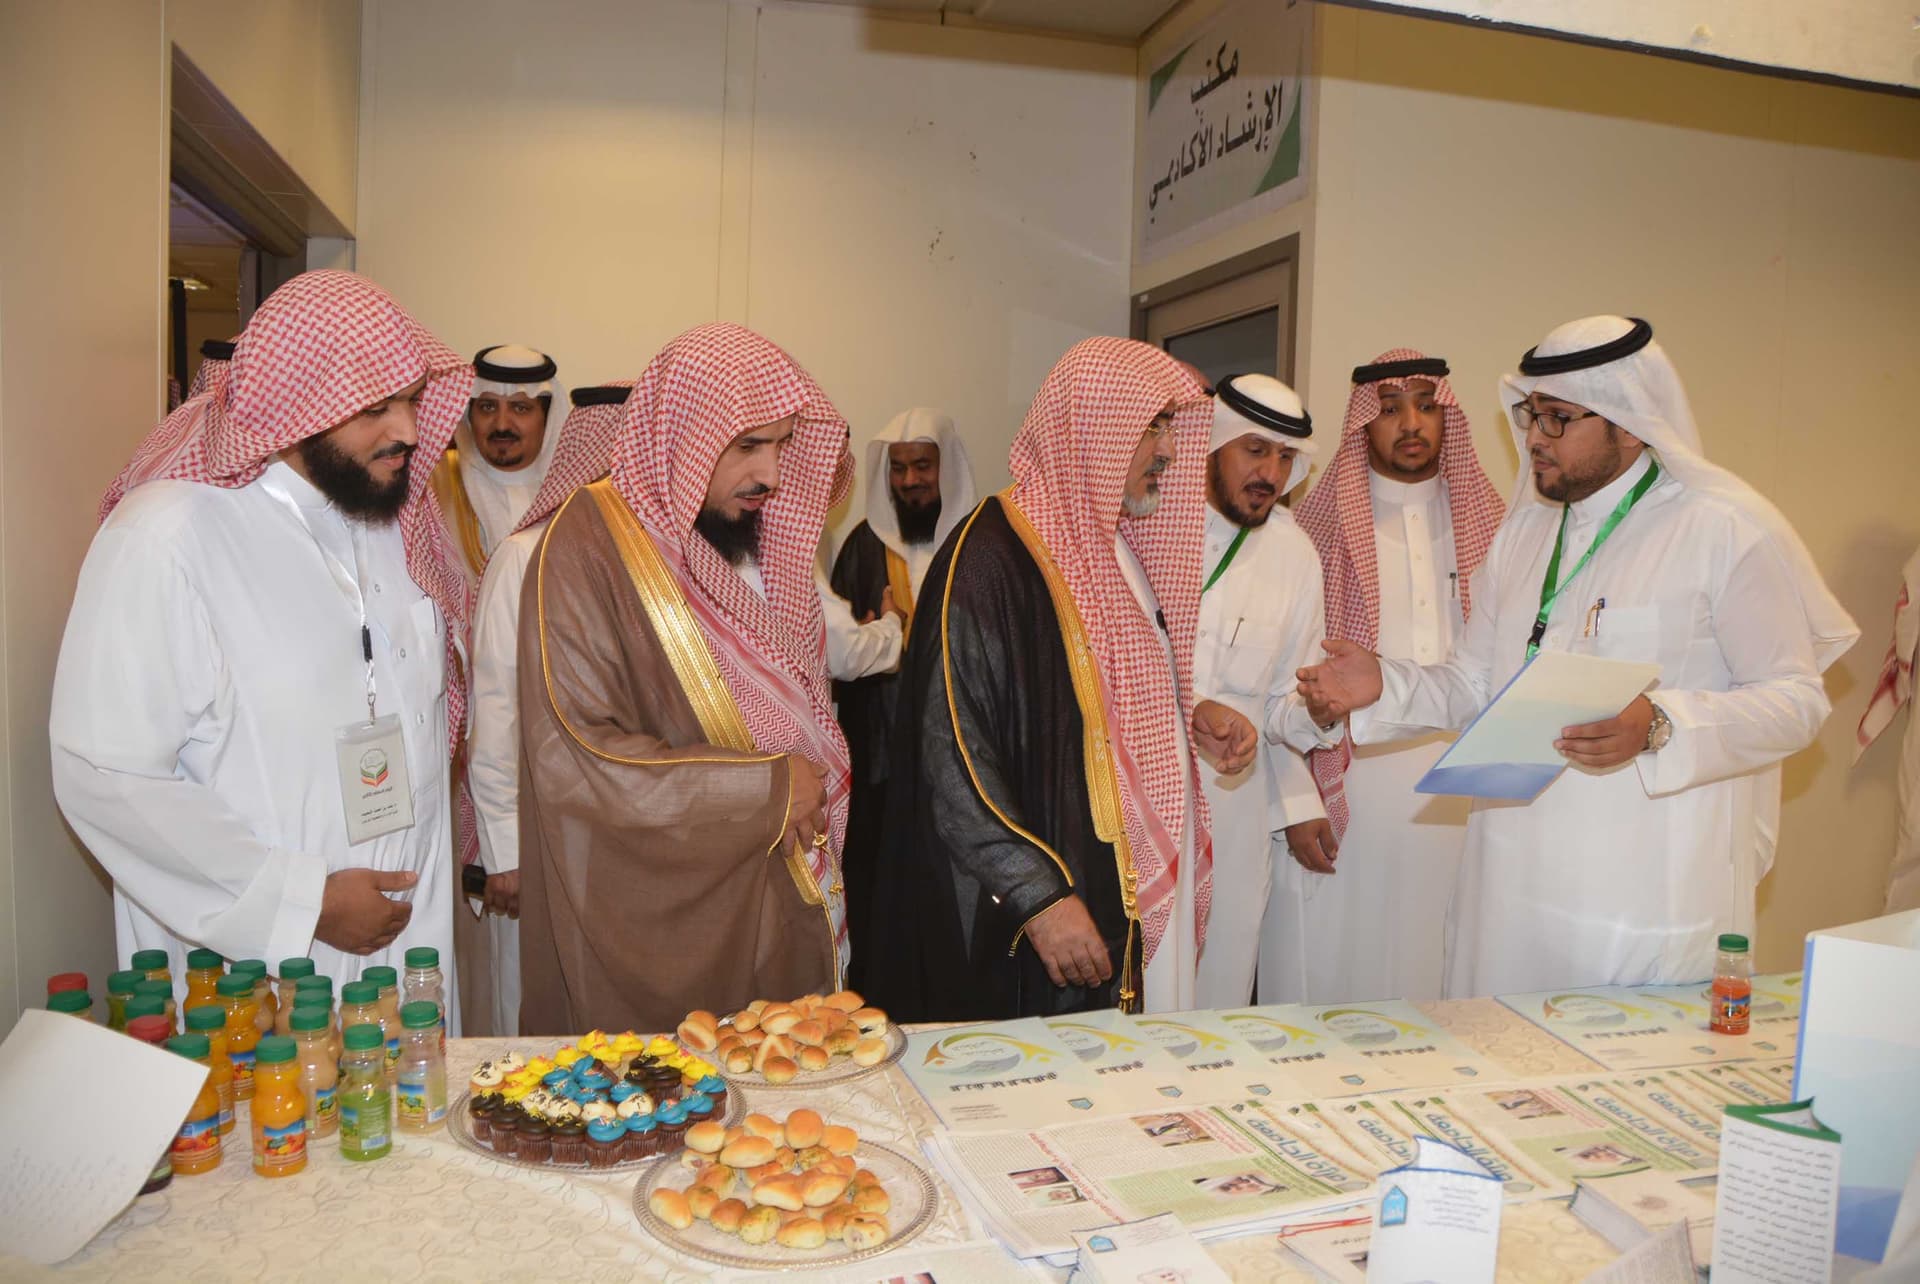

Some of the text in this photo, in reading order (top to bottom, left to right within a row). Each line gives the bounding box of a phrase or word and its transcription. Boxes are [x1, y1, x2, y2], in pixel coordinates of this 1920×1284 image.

[1191, 39, 1239, 116] مكتب
[1149, 80, 1283, 225] الإرشاد الأكاديمي
